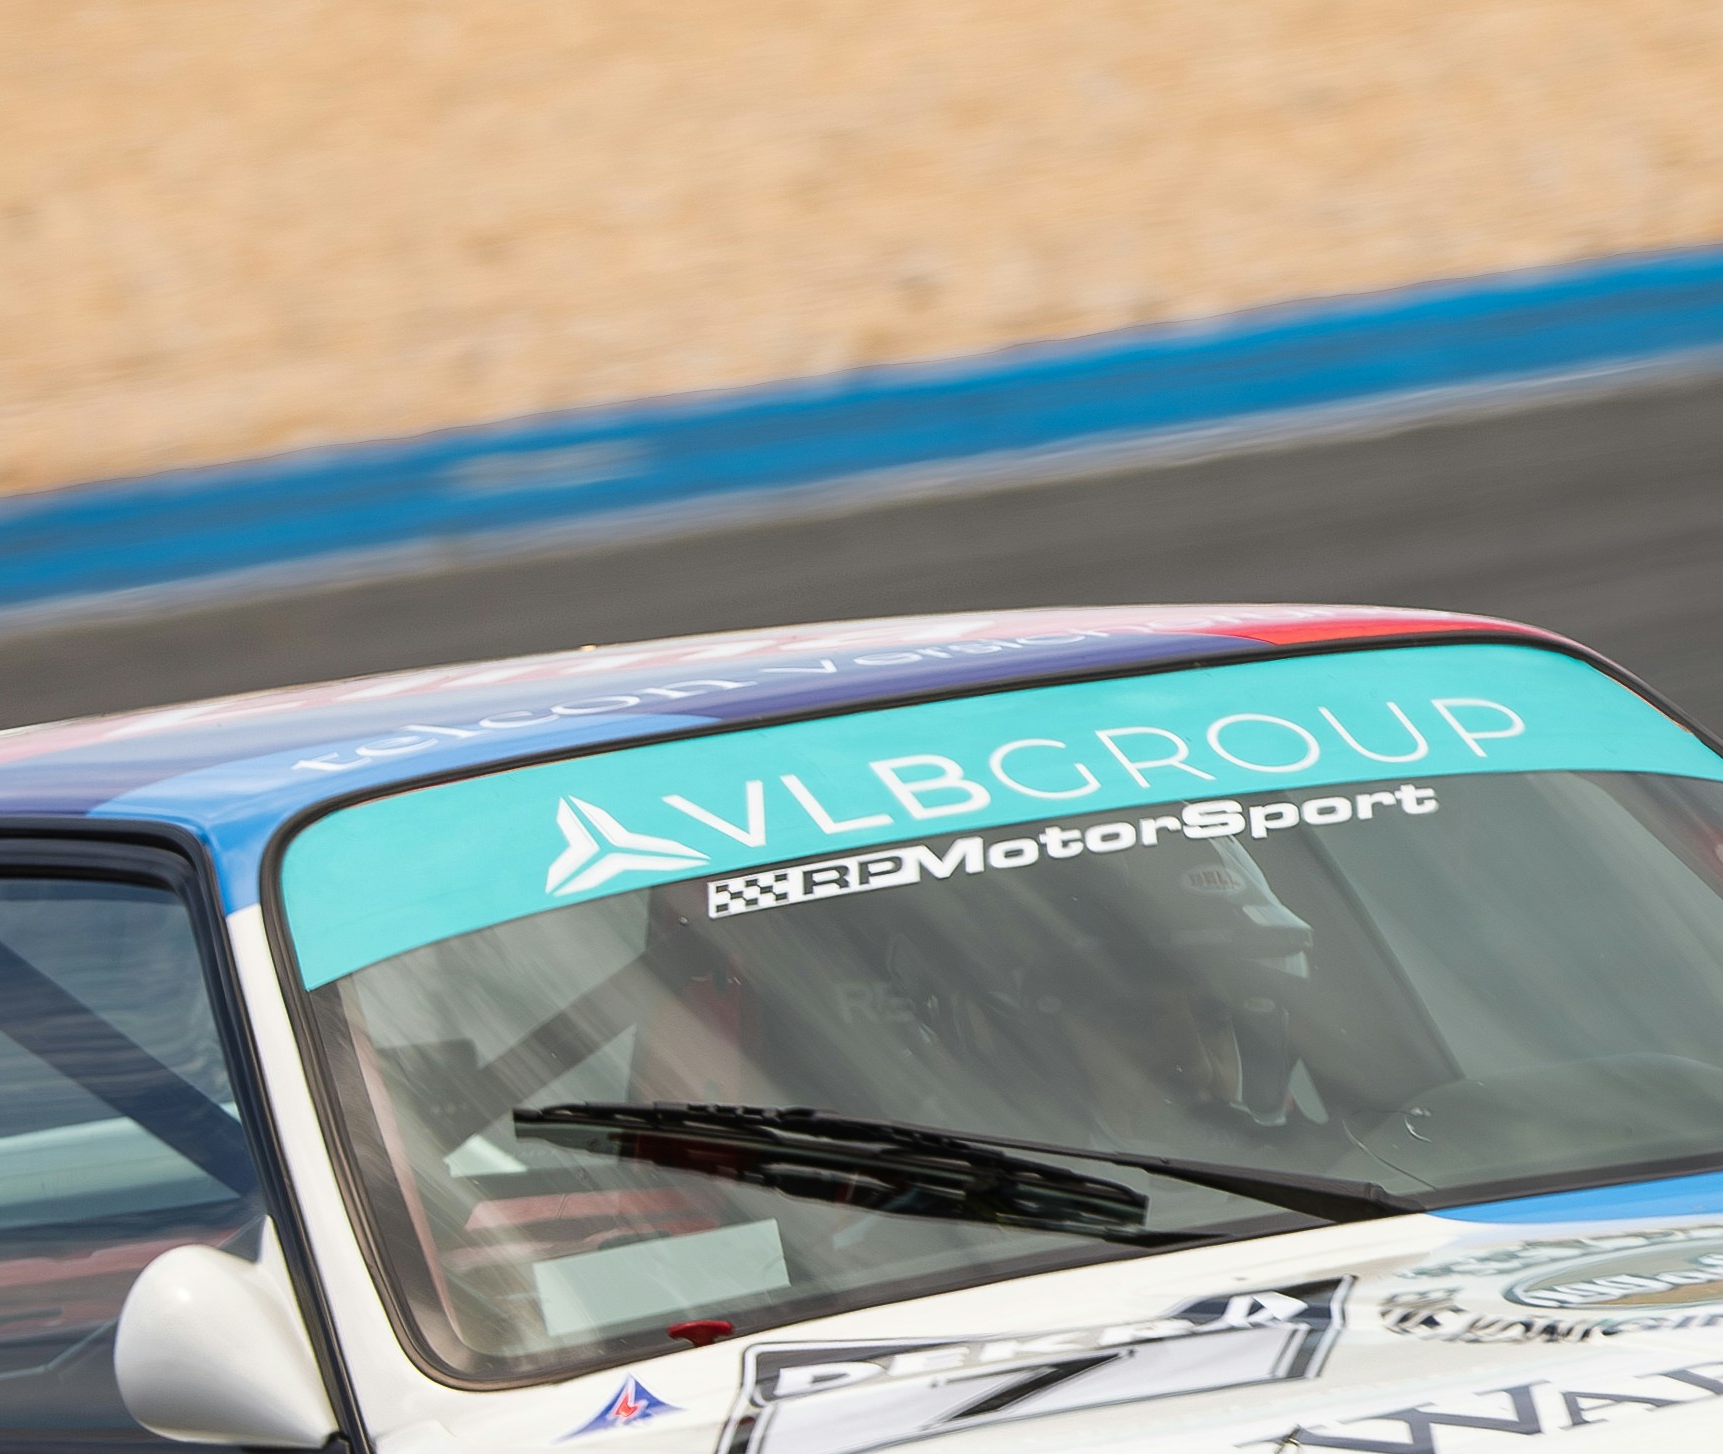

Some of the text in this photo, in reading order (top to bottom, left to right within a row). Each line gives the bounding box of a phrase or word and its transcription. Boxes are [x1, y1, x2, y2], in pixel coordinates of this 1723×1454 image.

[289, 677, 757, 774] telcon
[662, 696, 1527, 848] VLBGROUP
[800, 783, 1440, 897] RPMotorSport
